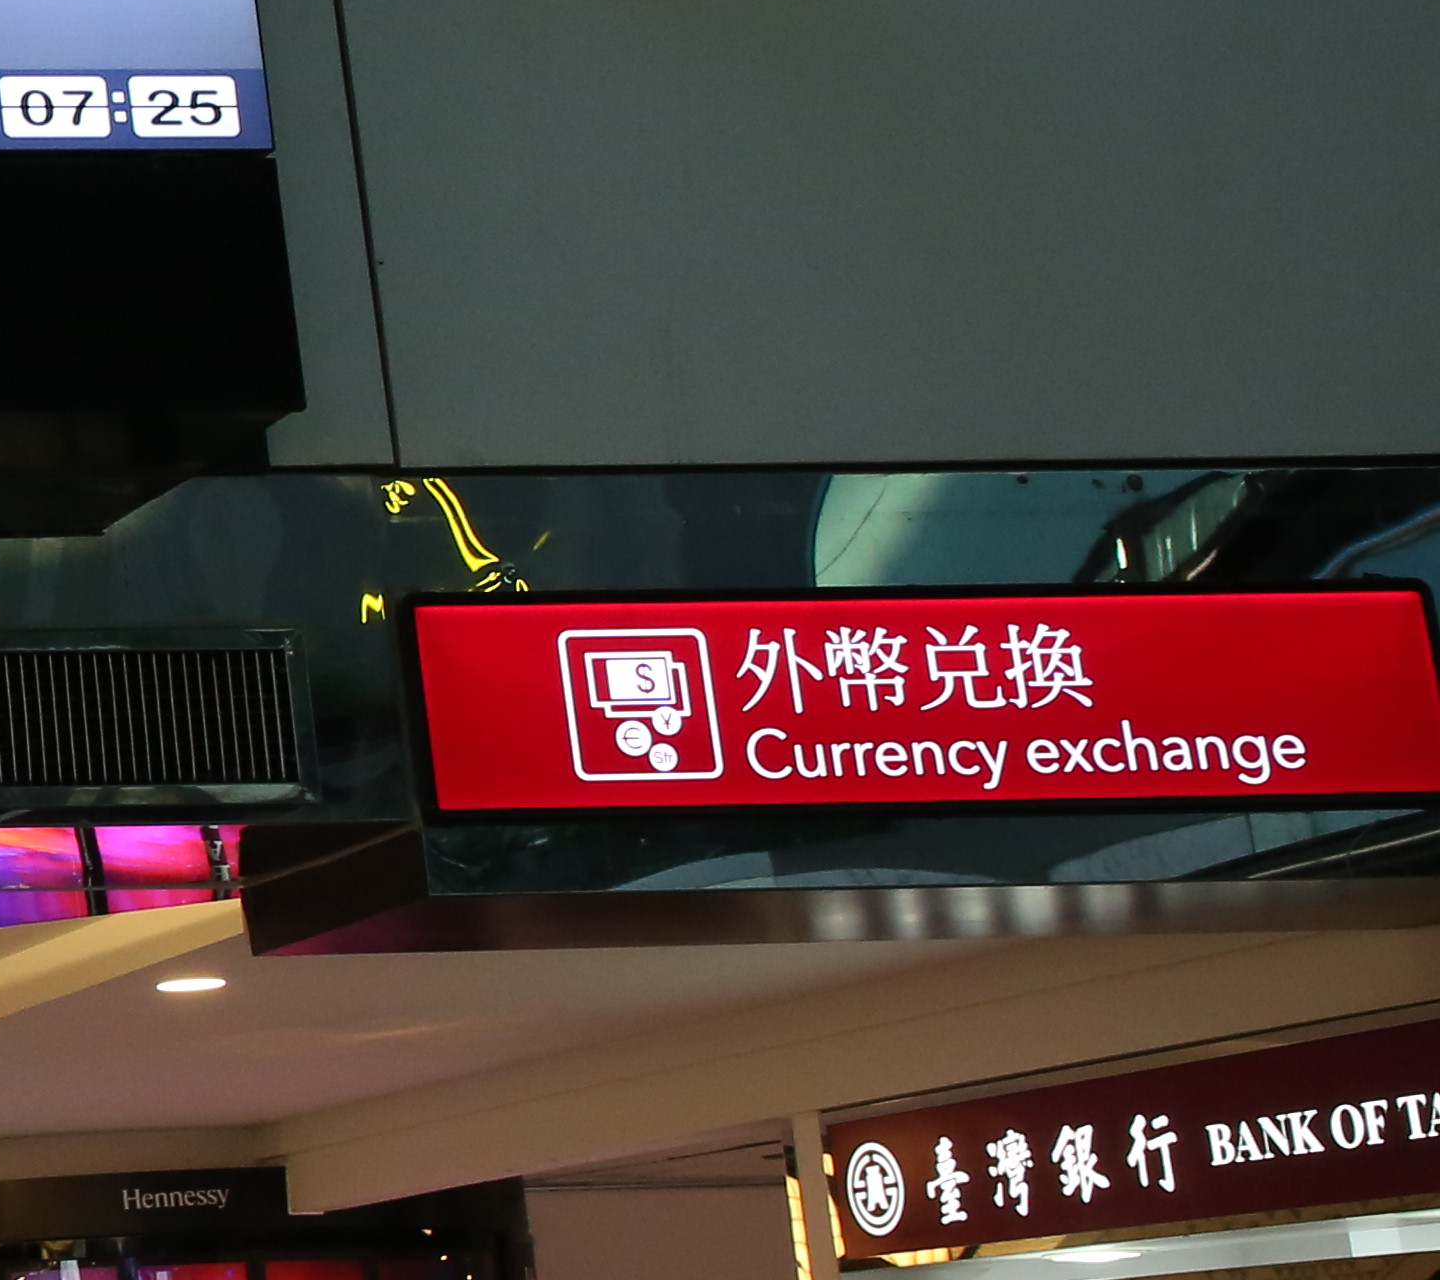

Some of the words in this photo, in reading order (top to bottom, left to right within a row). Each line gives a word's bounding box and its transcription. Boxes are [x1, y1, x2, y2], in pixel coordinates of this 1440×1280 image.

[17, 86, 224, 127] 07:25
[746, 727, 1008, 790] Currency
[1026, 719, 1306, 785] exchange
[926, 1114, 1178, 1225] 臺灣銀行
[1205, 1109, 1325, 1167] BANK
[1330, 1099, 1388, 1150] OF
[122, 1187, 230, 1211] Hennessy
